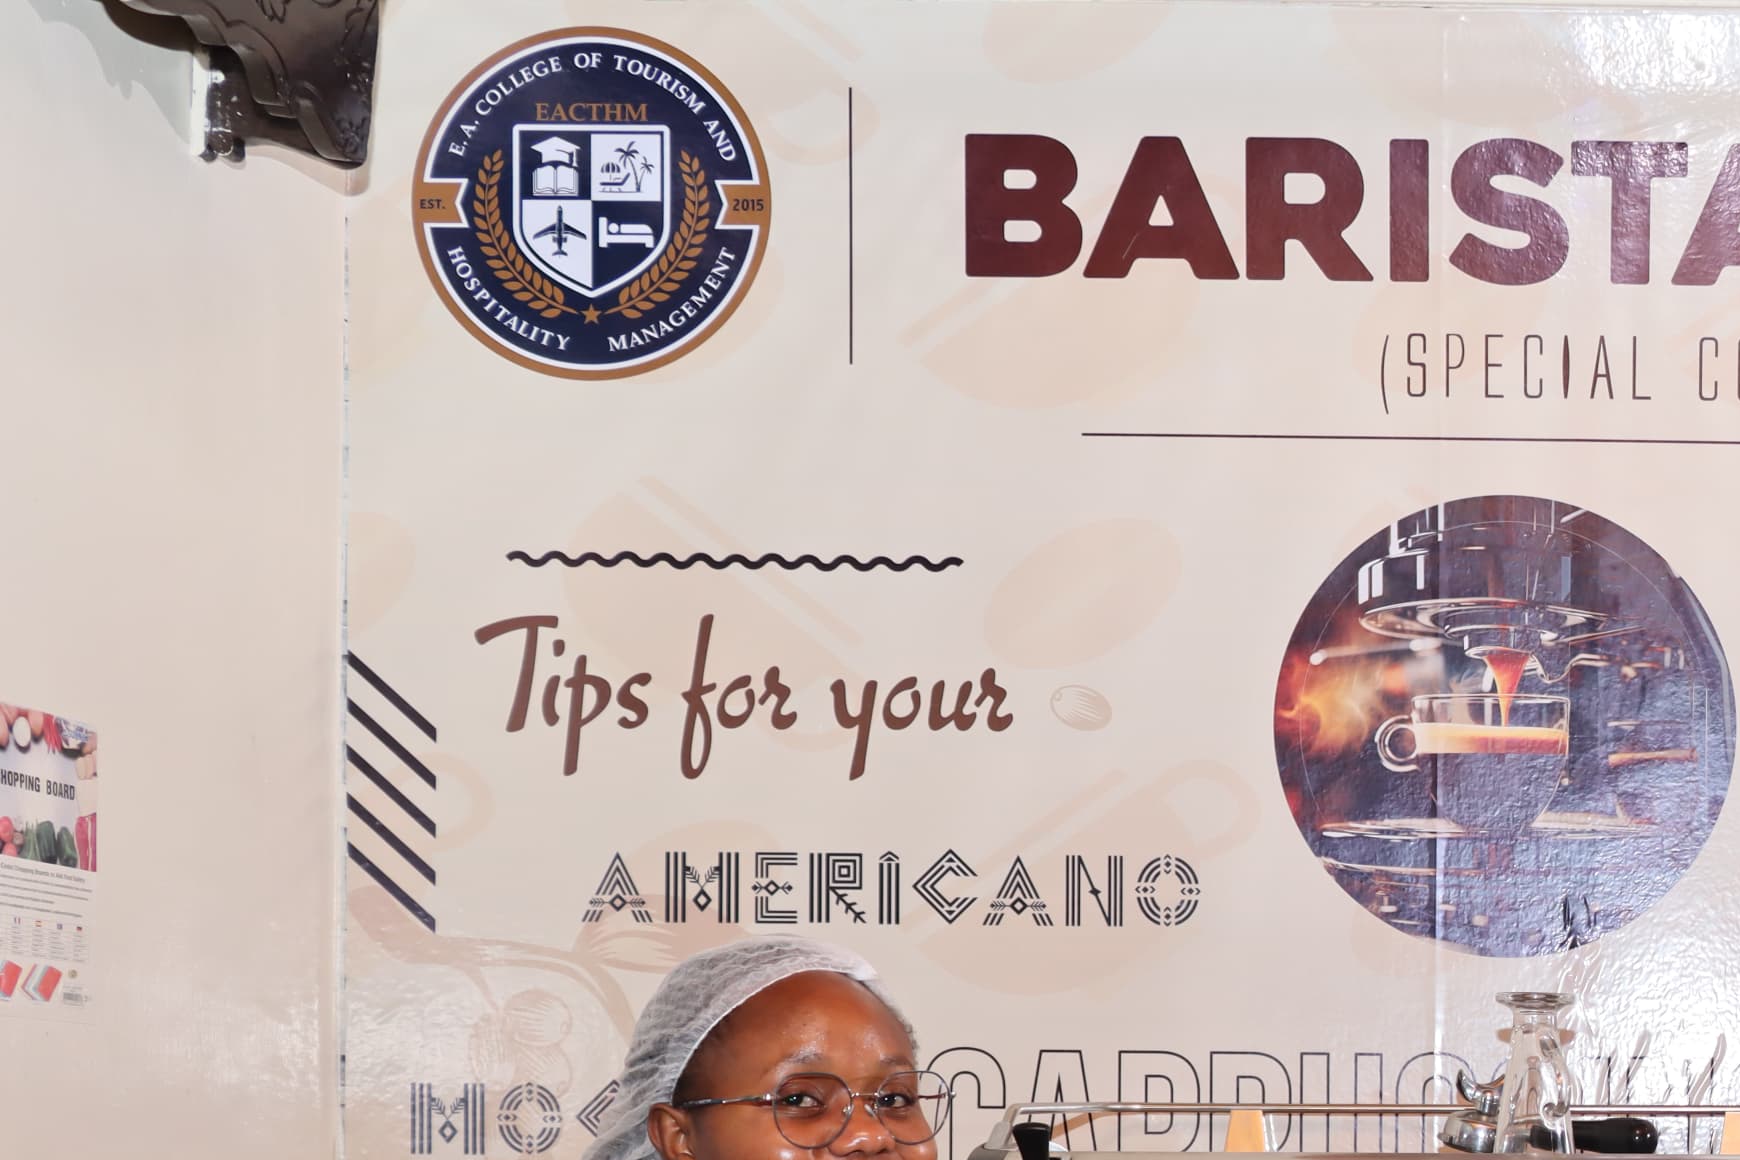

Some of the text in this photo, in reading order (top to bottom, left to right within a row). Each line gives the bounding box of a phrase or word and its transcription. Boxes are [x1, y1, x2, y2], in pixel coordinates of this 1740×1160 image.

[475, 56, 562, 116] COLLEGE
[573, 52, 602, 69] OF
[613, 54, 706, 115] TOURISM
[703, 118, 737, 163] AND
[535, 102, 648, 122] EACTHM
[419, 198, 446, 210] EST.
[732, 198, 765, 212] 2015
[447, 246, 571, 351] HOSPITALITY
[607, 247, 736, 352] MANAGEMENT
[1380, 332, 1653, 415] (SPECIAL
[474, 613, 1015, 781] Tips for your
[0, 769, 75, 800] HOPPING BOARD
[581, 848, 1203, 929] AMERICANO
